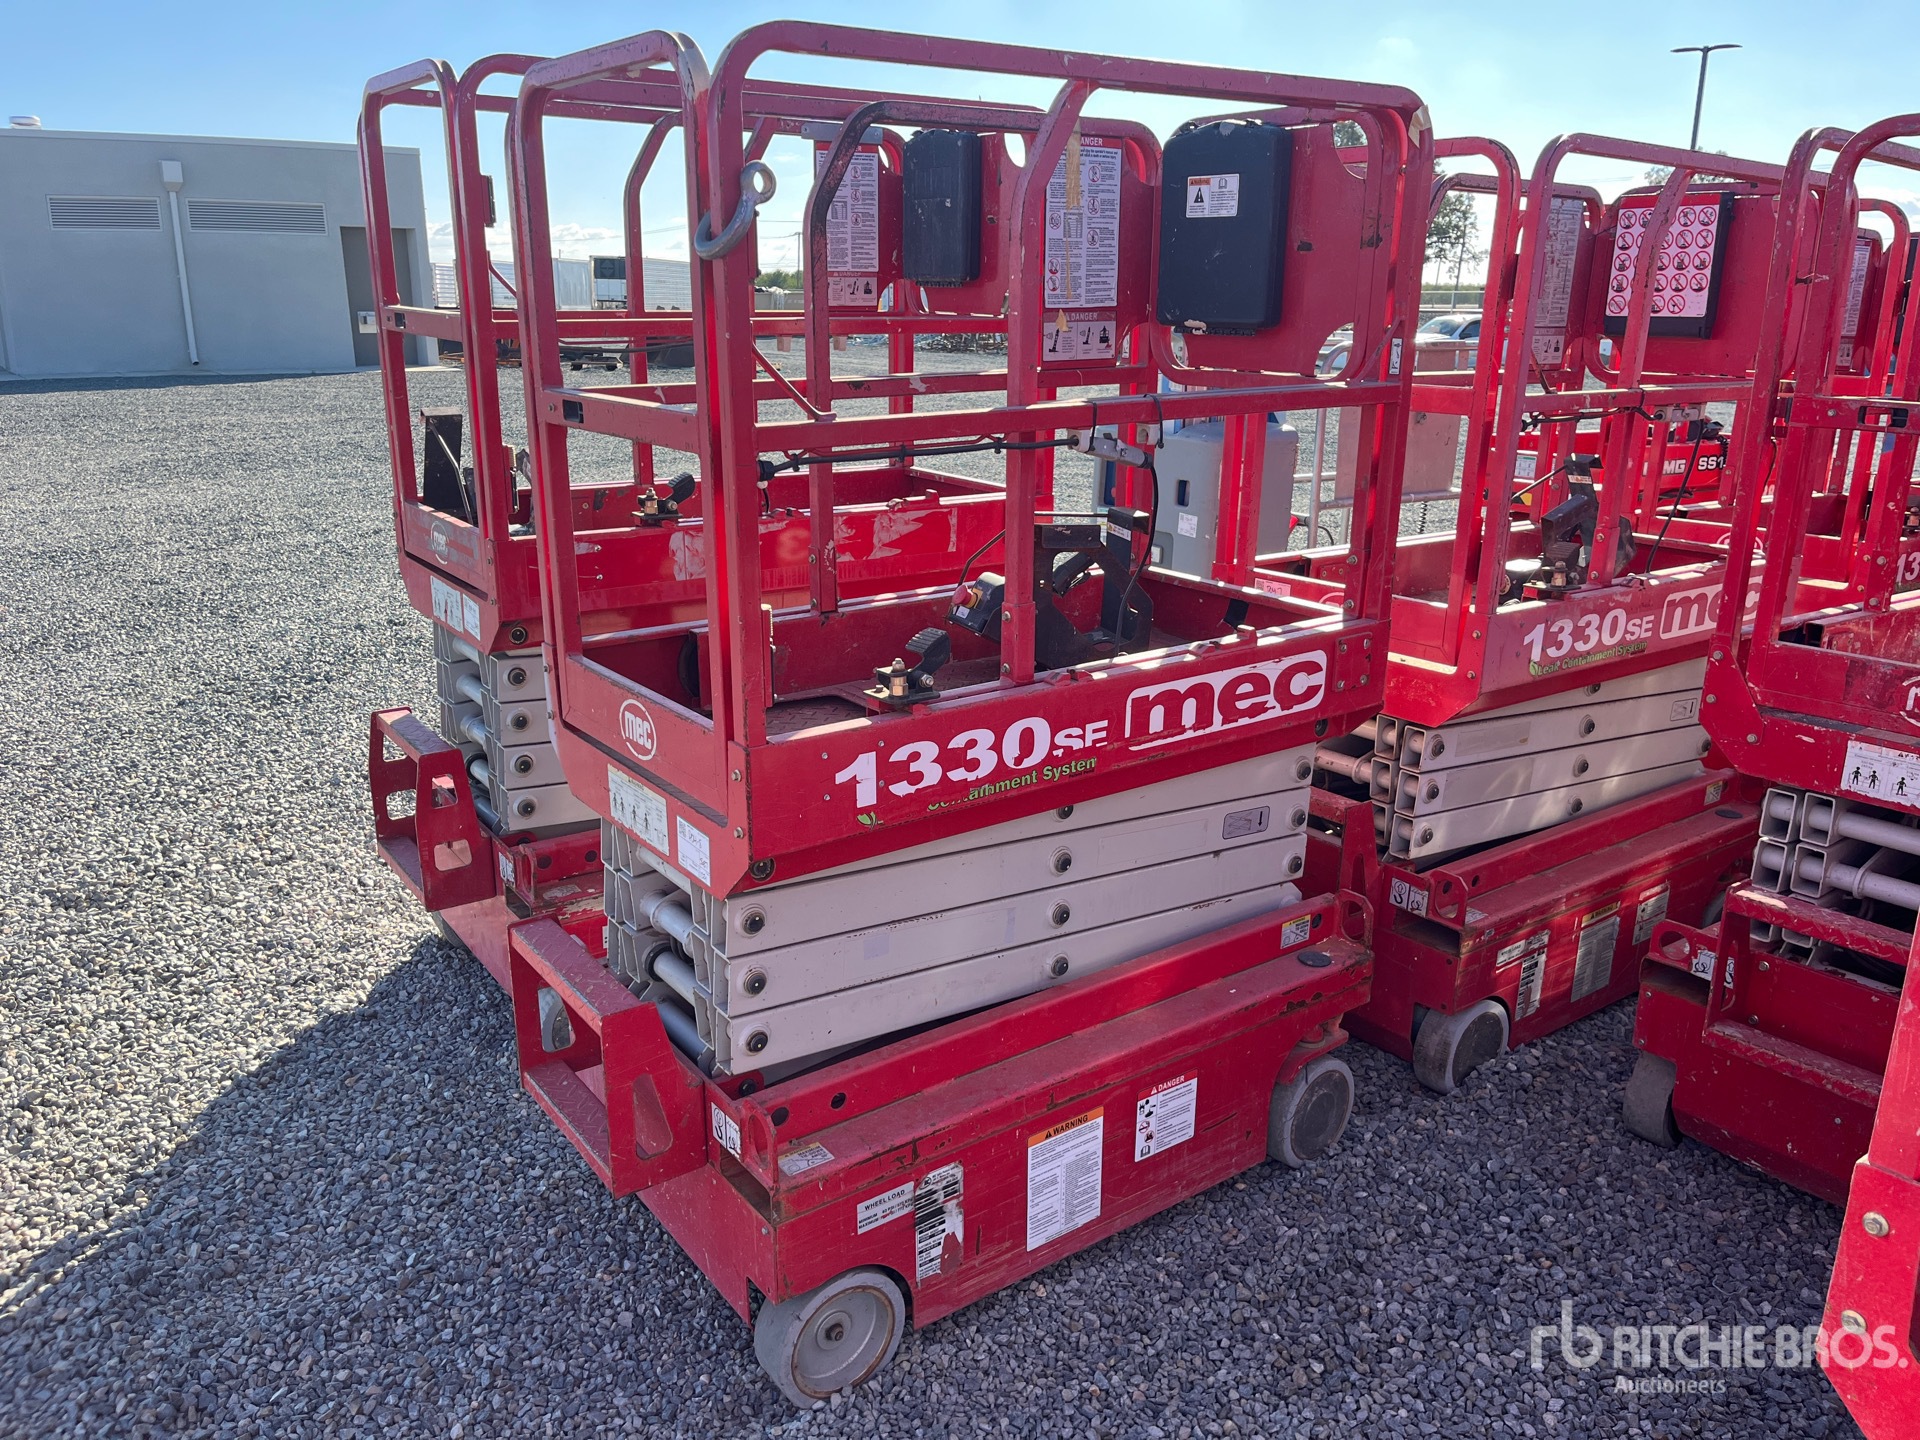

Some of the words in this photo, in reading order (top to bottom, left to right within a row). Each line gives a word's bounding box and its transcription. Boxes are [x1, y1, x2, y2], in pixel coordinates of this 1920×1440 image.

[1080, 136, 1103, 146] ANGER
[1070, 312, 1098, 321] DANGER
[1538, 660, 1560, 676] Leak
[1562, 647, 1616, 669] Containment
[1617, 641, 1648, 658] System
[1128, 659, 1324, 745] mec
[624, 710, 652, 750] mec
[1158, 1075, 1185, 1092] DANGER
[1052, 1114, 1088, 1136] WARNING
[864, 1197, 886, 1211] WHEEL
[887, 1189, 905, 1201] LOAD
